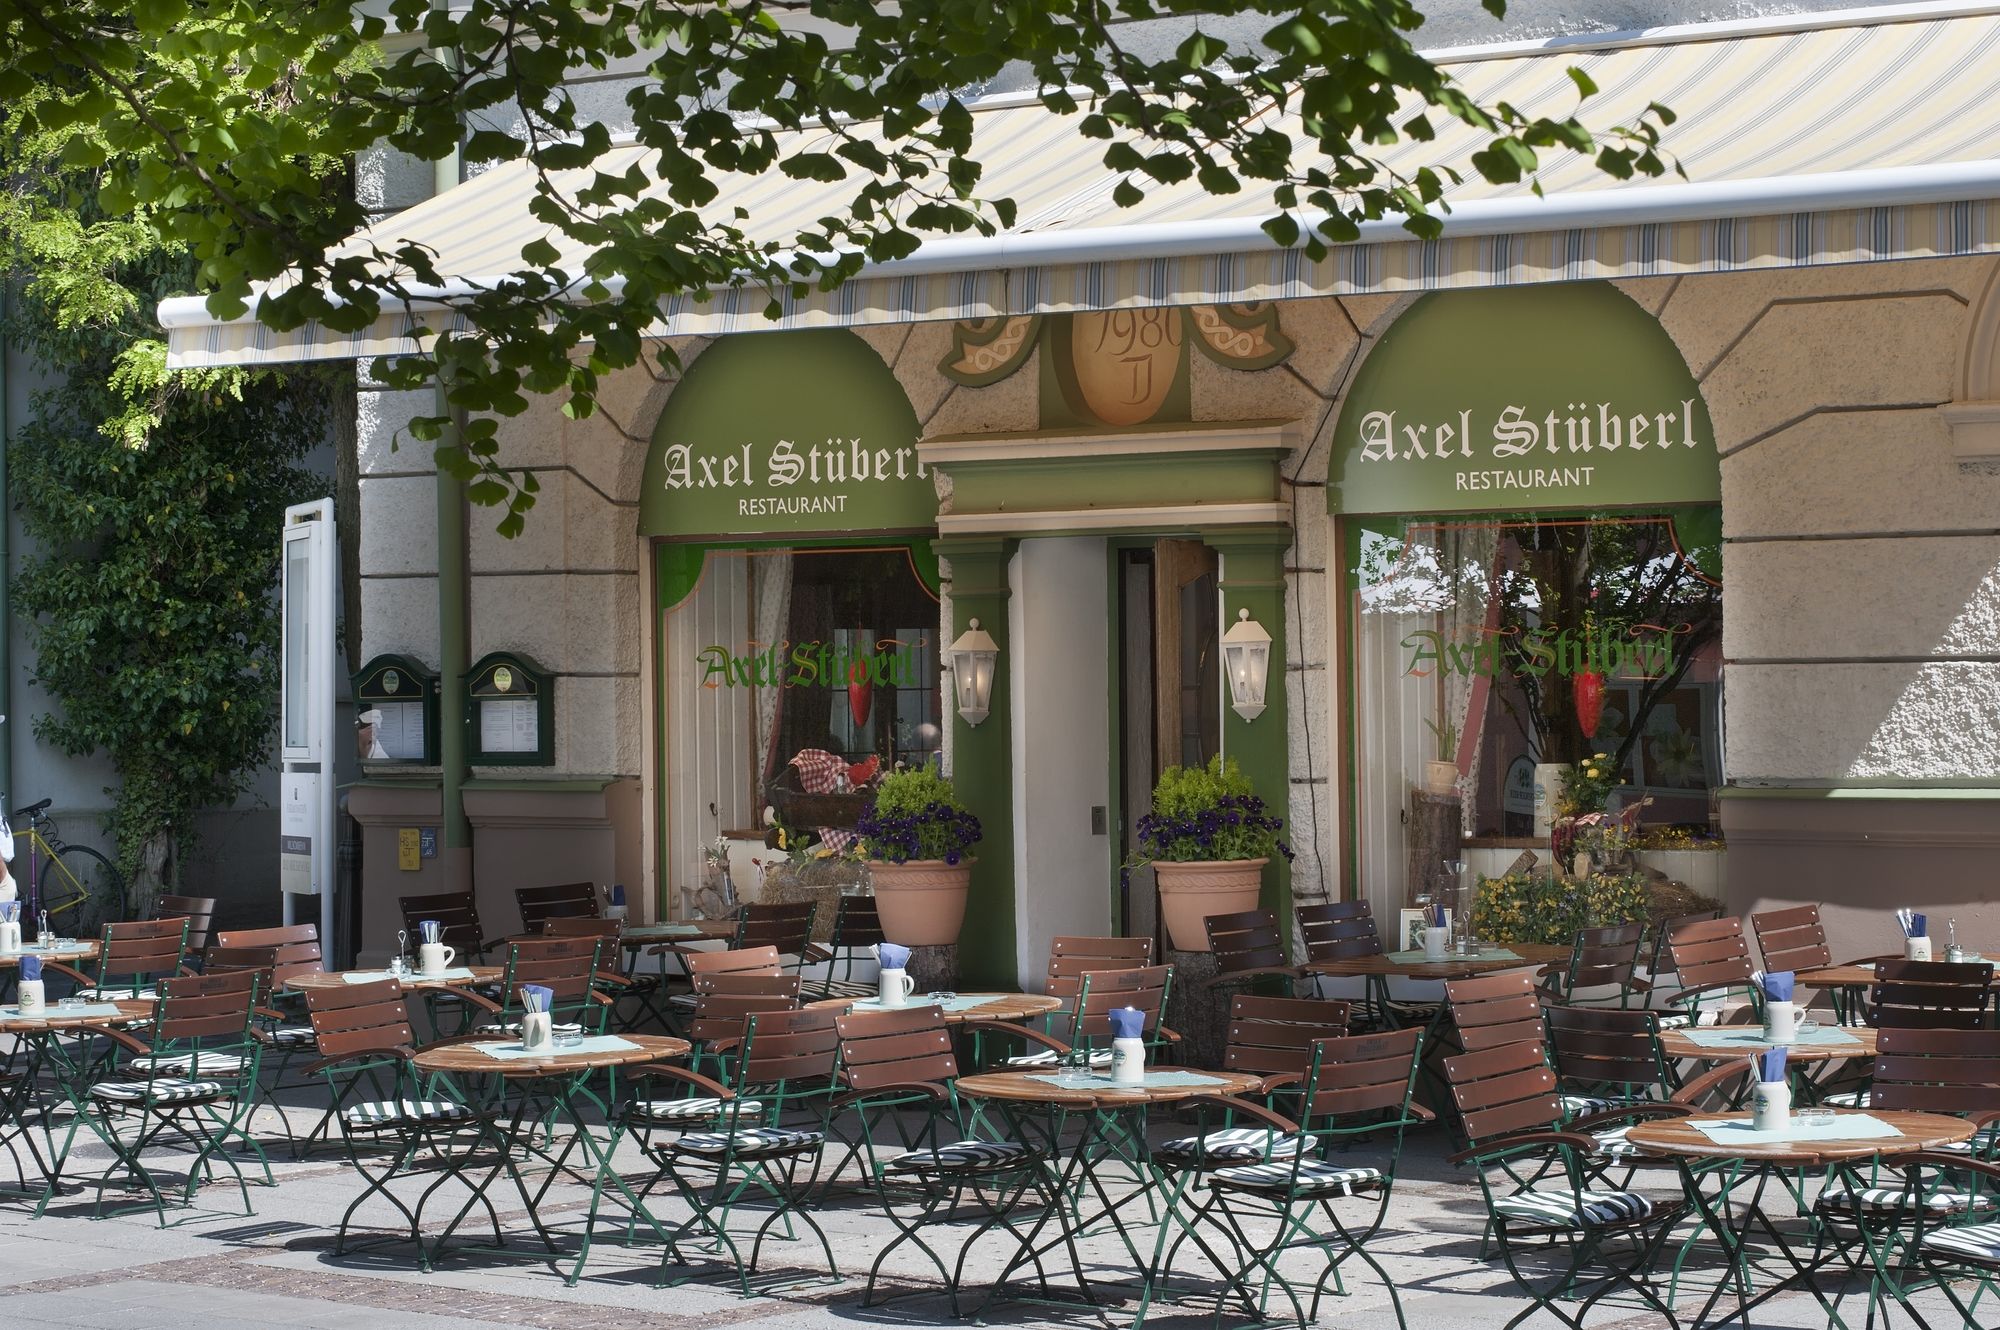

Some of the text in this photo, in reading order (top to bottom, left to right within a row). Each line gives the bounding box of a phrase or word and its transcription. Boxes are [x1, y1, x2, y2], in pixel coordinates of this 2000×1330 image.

[1359, 398, 1698, 463] Axel Stüberl
[664, 442, 755, 490] Axel
[1456, 467, 1595, 491] RESTAURANT
[739, 495, 848, 516] RESTAURANT
